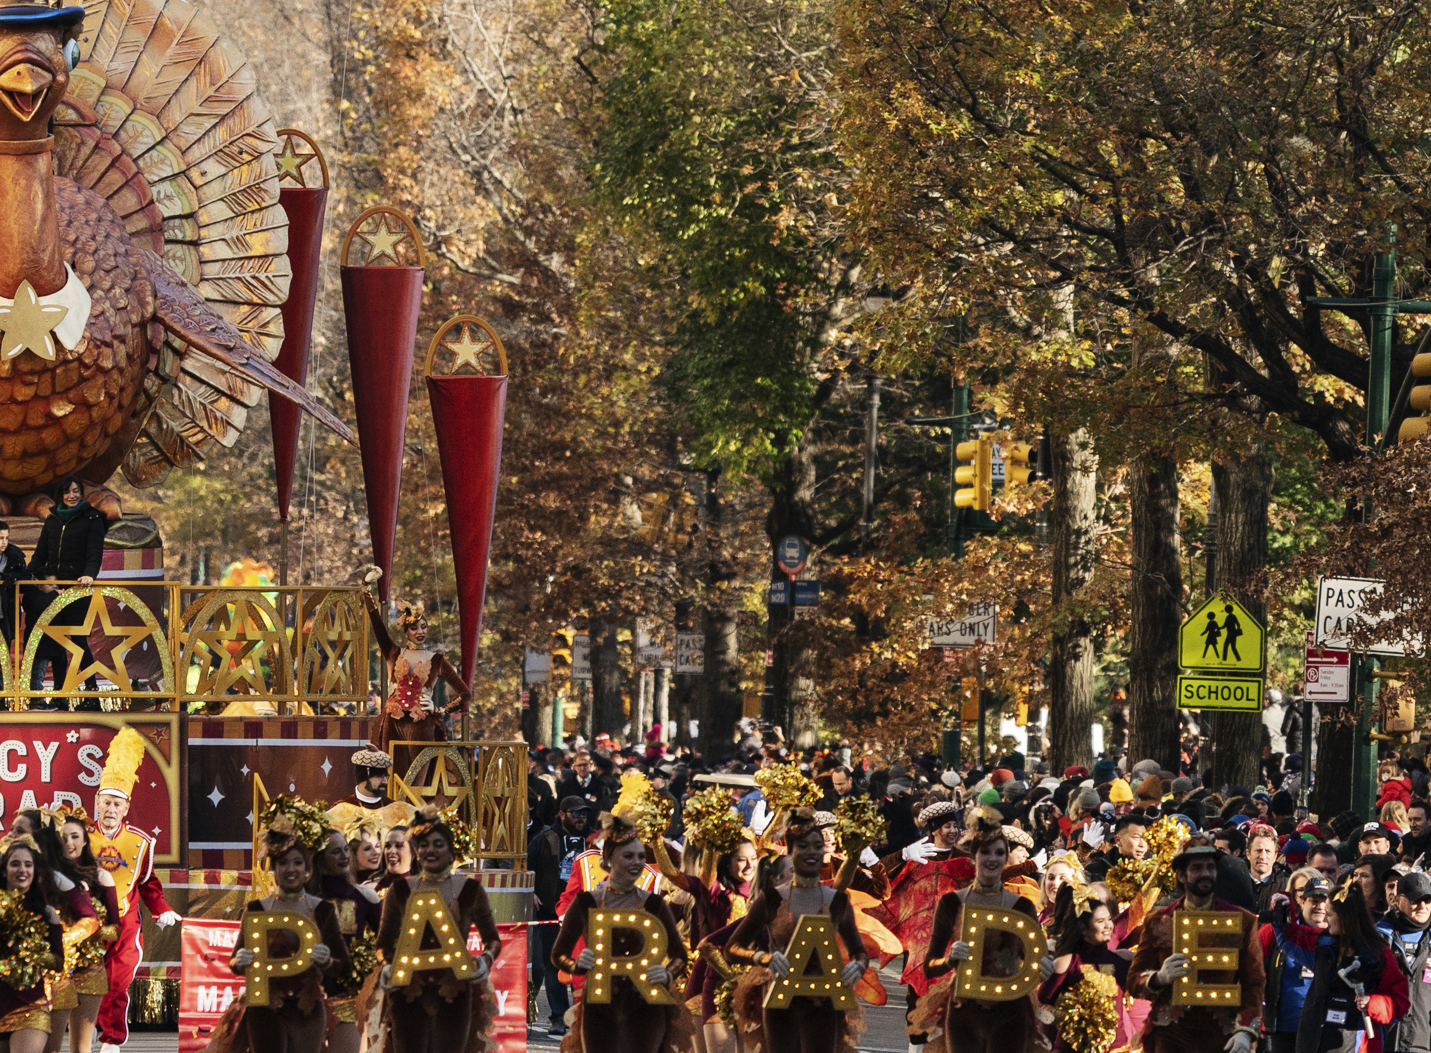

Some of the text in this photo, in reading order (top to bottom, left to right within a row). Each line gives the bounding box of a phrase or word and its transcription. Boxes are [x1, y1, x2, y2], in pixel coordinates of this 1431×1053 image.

[960, 621, 991, 637] ONLY
[1184, 684, 1256, 702] SCHOOL
[245, 888, 1242, 1011] P A R A D E
